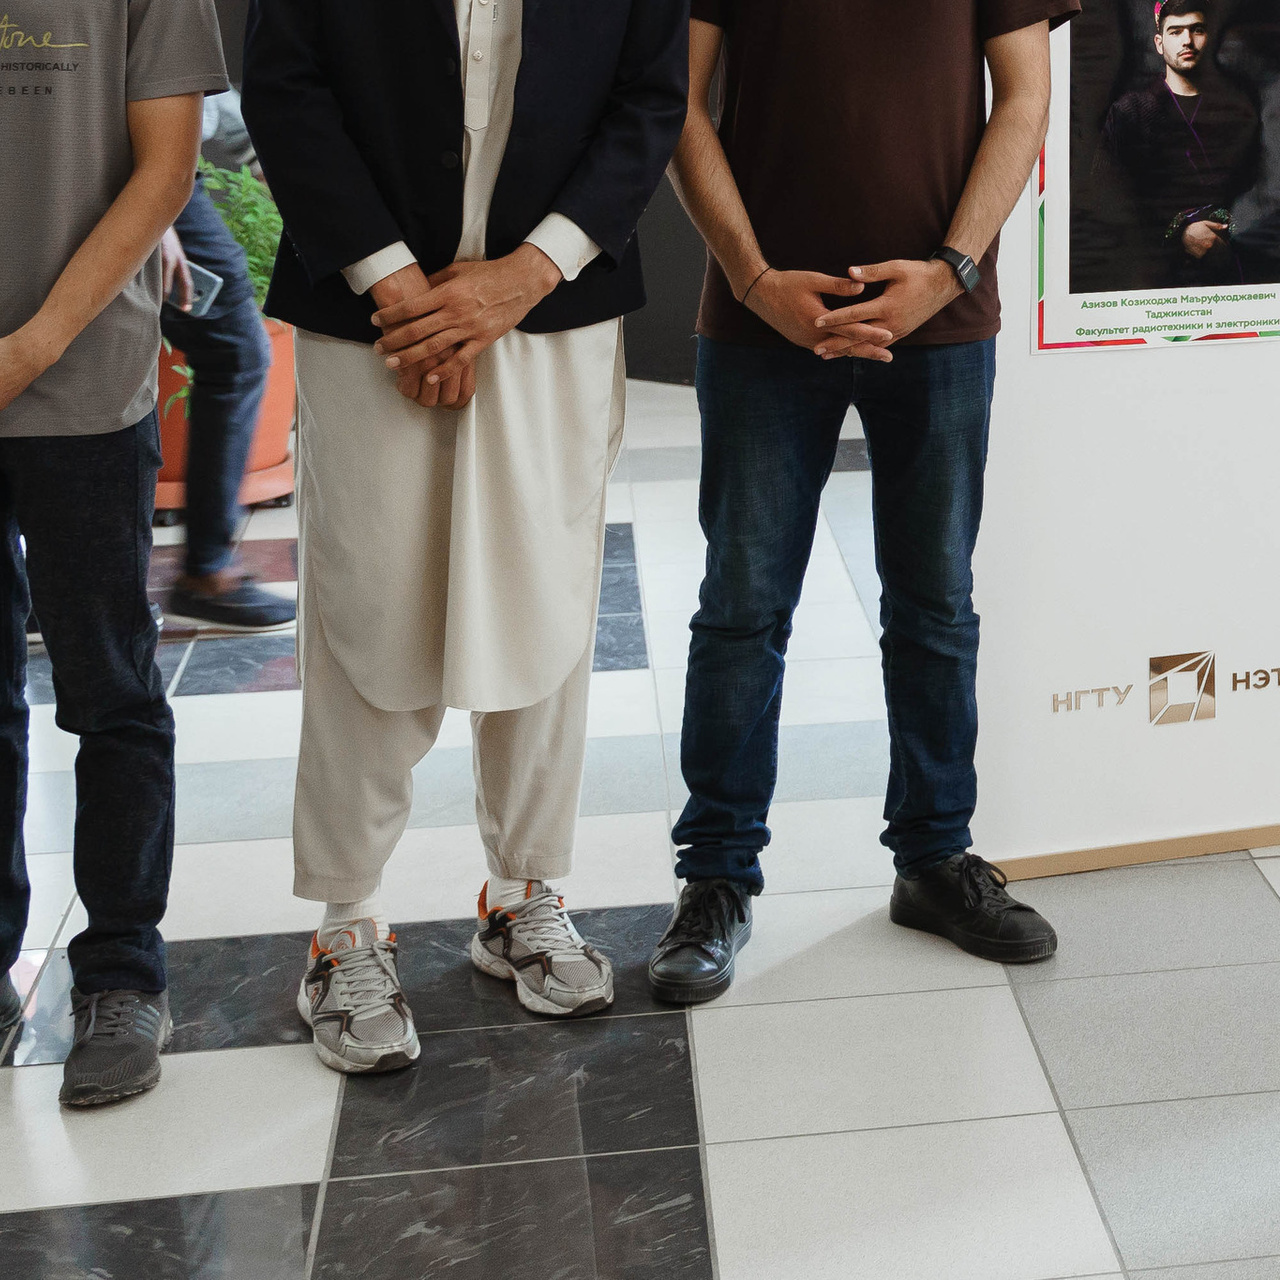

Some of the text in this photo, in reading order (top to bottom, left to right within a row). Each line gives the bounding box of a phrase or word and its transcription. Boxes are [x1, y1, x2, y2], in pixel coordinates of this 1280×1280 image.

[0, 62, 79, 72] HISTORICALLY
[1081, 291, 1276, 310] Азизов Козиходжа Маъруфходжаевич
[1145, 308, 1212, 320] Таджикистан
[1075, 317, 1280, 337] Факультет радиотехники и электроники
[1052, 683, 1134, 713] НГТУ
